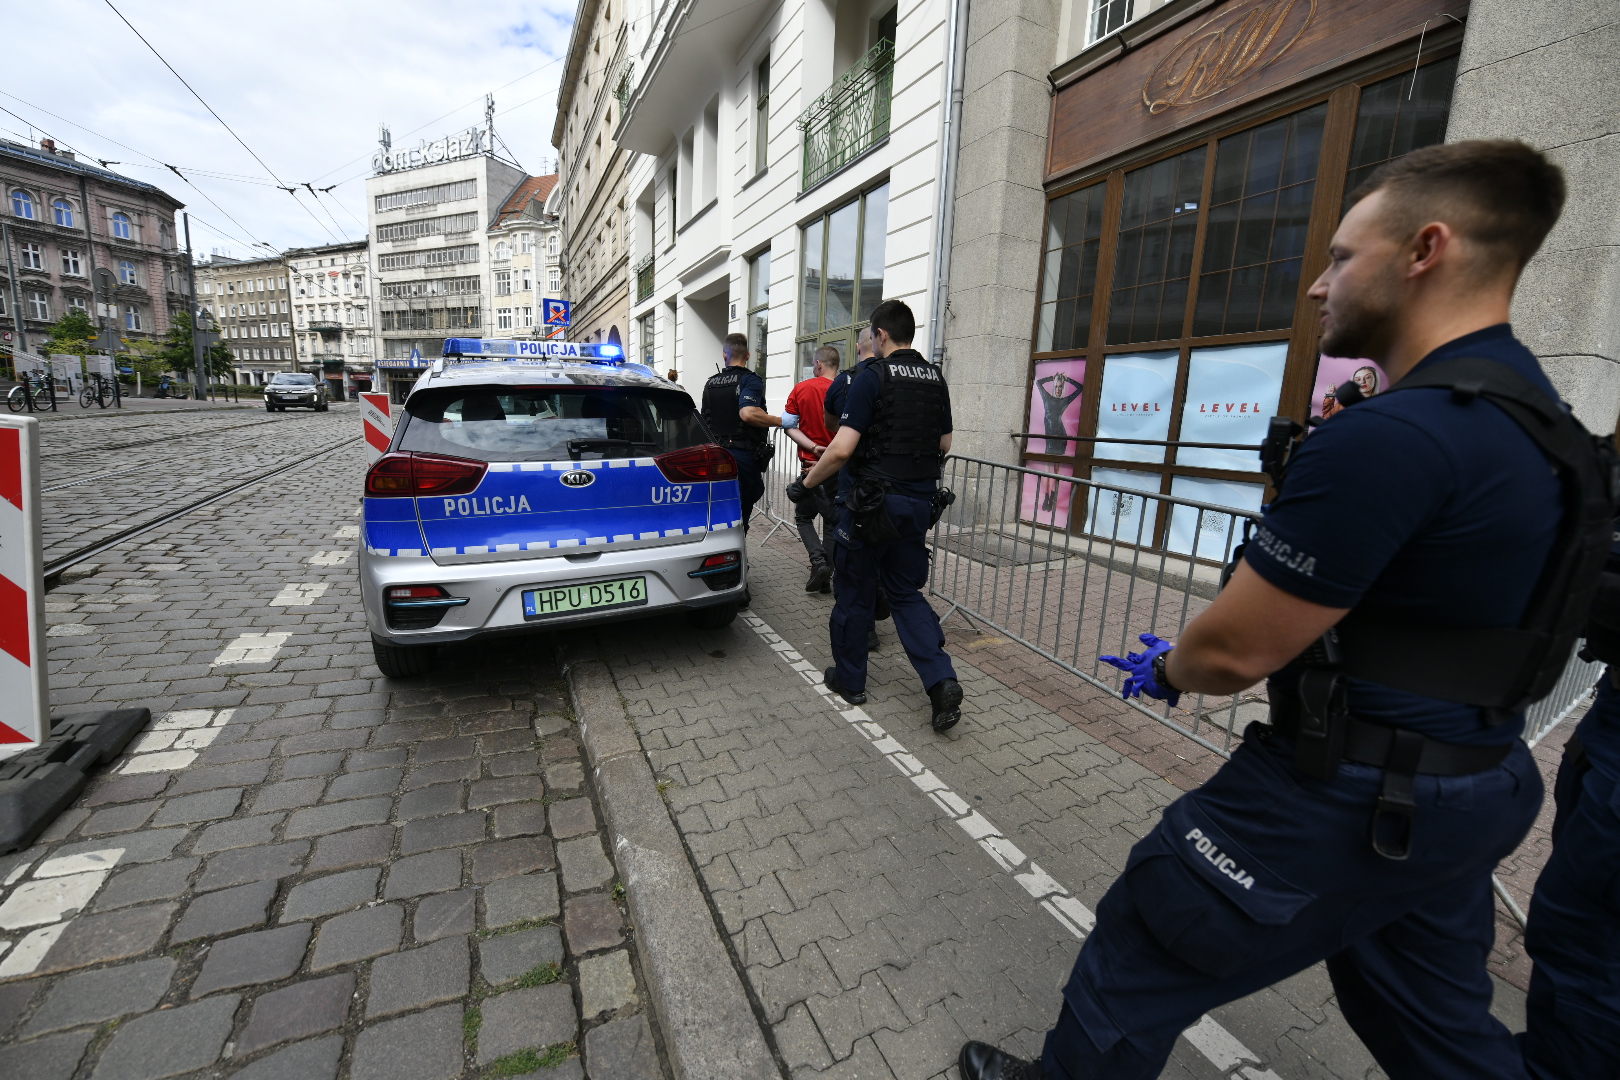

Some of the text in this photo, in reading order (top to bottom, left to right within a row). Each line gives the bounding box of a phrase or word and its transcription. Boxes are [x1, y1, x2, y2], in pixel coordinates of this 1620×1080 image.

[372, 148, 411, 172] dom
[519, 342, 578, 357] POLICJA
[708, 374, 738, 386] POLICJA
[889, 364, 940, 382] POLICJA
[1111, 402, 1161, 412] LEVEL
[1199, 402, 1260, 413] LEVEL
[566, 474, 590, 485] KIA
[651, 485, 693, 504] U137
[443, 494, 532, 517] POLICJA
[538, 580, 641, 612] HPU D516
[1184, 827, 1255, 891] POLICJA
